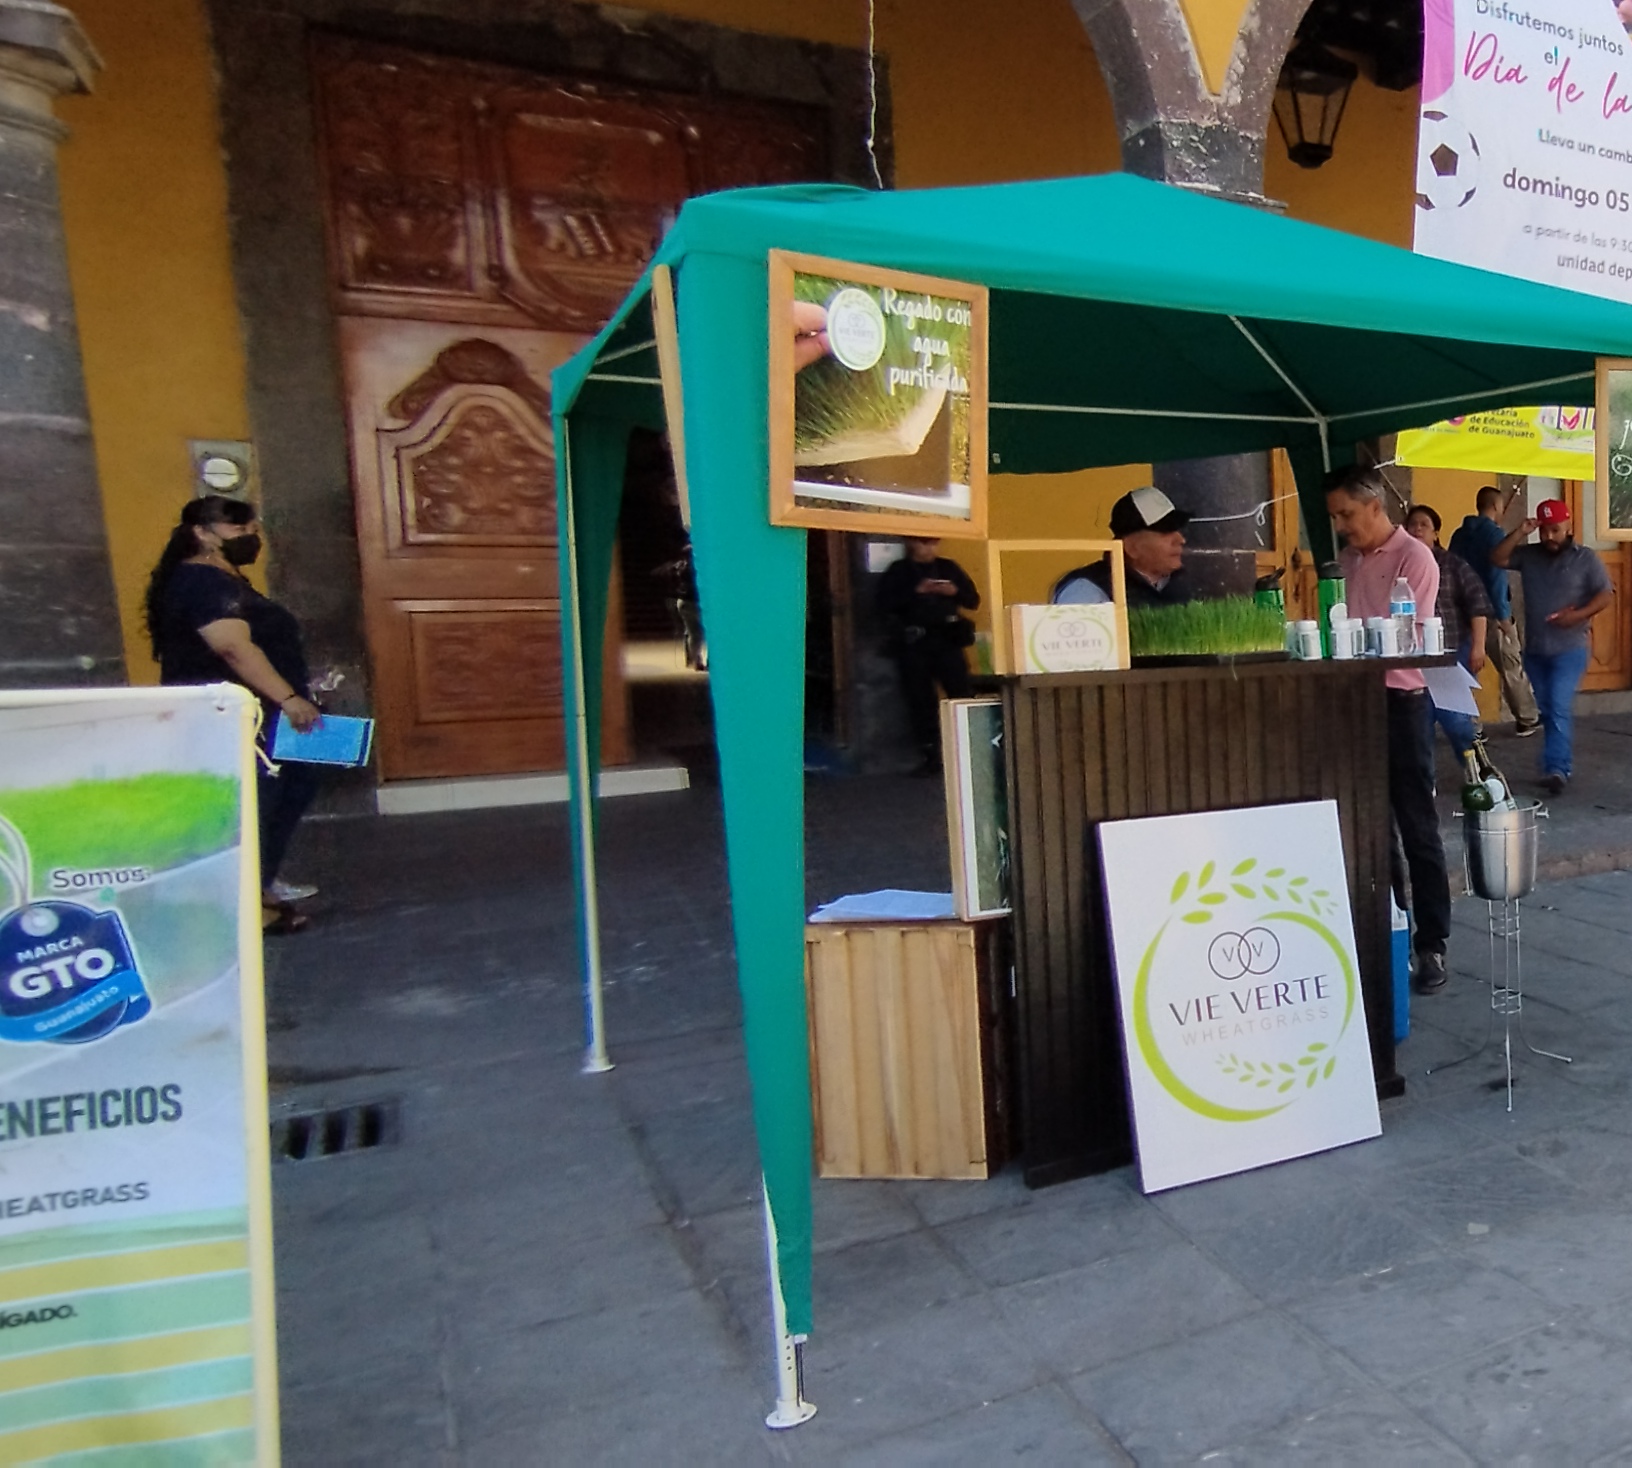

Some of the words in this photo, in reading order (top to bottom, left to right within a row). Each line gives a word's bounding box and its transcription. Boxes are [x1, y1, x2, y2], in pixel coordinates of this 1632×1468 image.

[1477, 0, 1573, 40] Disfrutemos
[1578, 28, 1623, 56] juntos
[1544, 46, 1558, 65] el
[1548, 56, 1584, 113] de
[1602, 72, 1632, 118] la
[1538, 128, 1574, 151] Lleva
[1578, 142, 1595, 155] un
[1503, 168, 1599, 208] domingo
[1605, 190, 1630, 212] 05
[1522, 224, 1532, 234] a
[1535, 226, 1571, 240] partir
[1573, 230, 1588, 244] de
[1590, 232, 1607, 248] las
[1557, 253, 1605, 274] unidad
[882, 288, 942, 330] Regado
[913, 336, 950, 366] agua
[890, 365, 969, 396] purificada
[1468, 425, 1480, 433] de
[1482, 426, 1535, 438] Guanajuato
[1470, 415, 1481, 423] de
[1483, 416, 1529, 428] Educación
[53, 868, 146, 889] Somos
[16, 936, 84, 963] MARCA
[9, 948, 115, 999] GTO
[1169, 994, 1223, 1026] VIE
[1230, 975, 1331, 1014] VERTE
[1182, 1007, 1329, 1046] WHEATGRASS
[0, 1083, 183, 1141] NEFICIOS
[0, 1182, 150, 1220] EATGRASS
